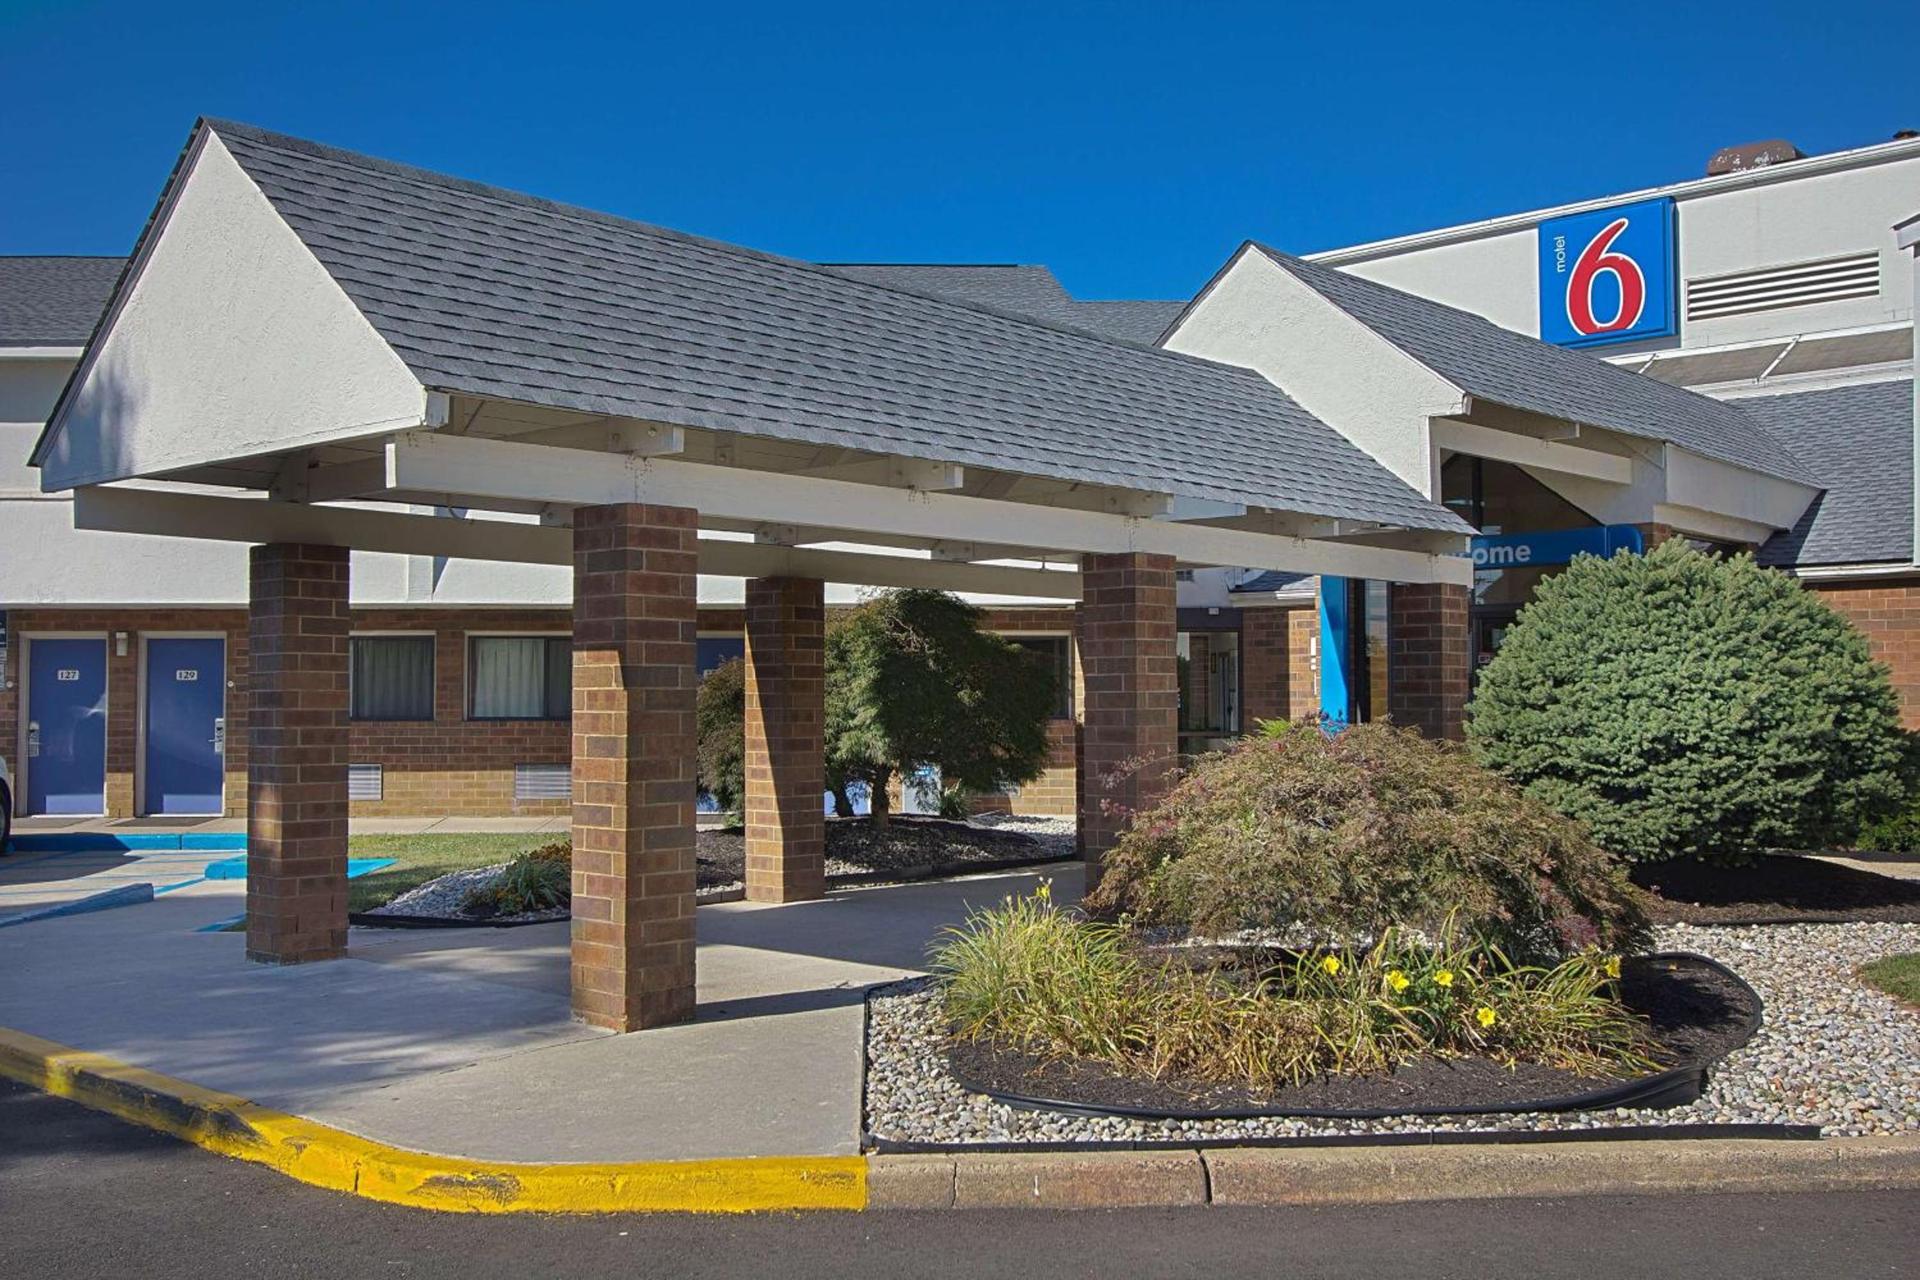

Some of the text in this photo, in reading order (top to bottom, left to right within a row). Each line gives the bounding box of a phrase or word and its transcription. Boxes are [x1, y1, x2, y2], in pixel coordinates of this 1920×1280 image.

[1554, 217, 1646, 336] motel 6
[1472, 544, 1531, 565] ome
[59, 671, 77, 680] 127
